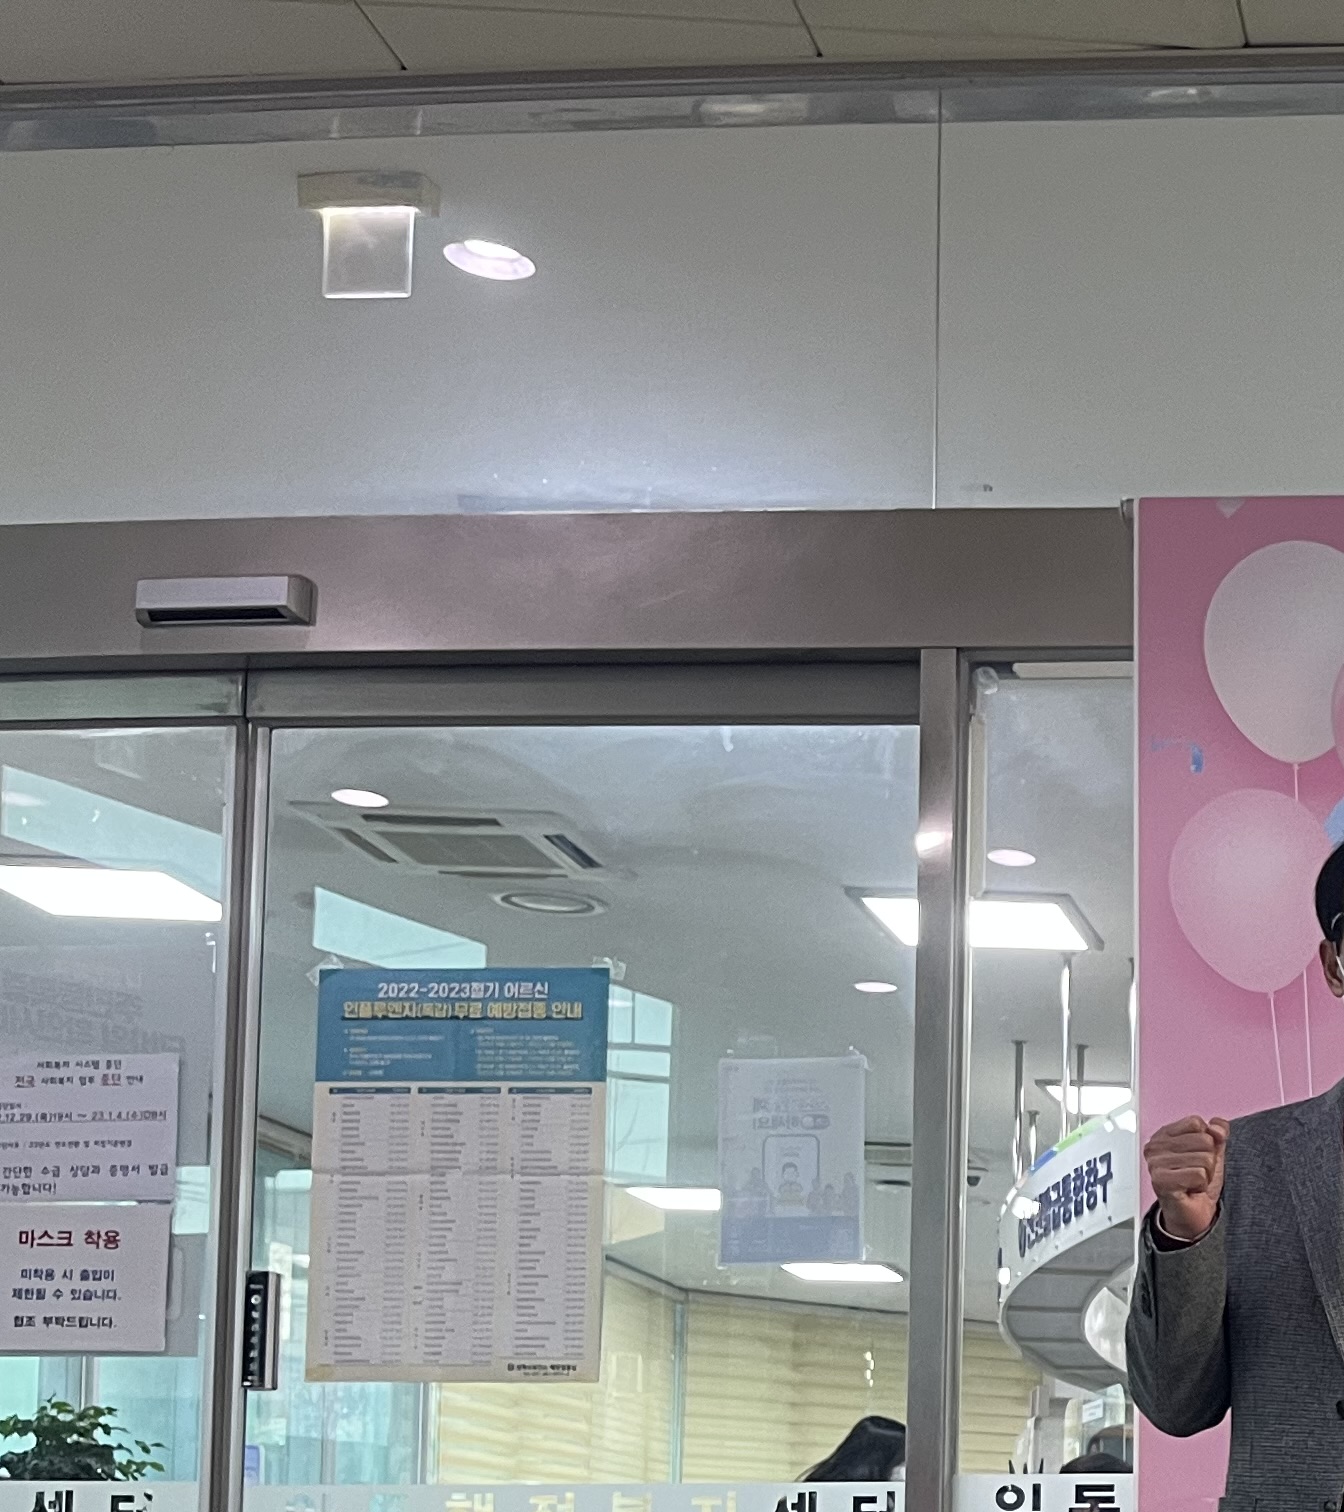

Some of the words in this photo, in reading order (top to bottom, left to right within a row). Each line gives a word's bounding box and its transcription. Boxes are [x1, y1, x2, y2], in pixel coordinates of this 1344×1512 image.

[504, 982, 549, 999] 어르신
[551, 1001, 582, 1018] 안내
[19, 1230, 74, 1247] 마스크
[84, 1229, 121, 1249] 착용
[20, 1268, 55, 1282] 미착용
[62, 1268, 73, 1281] 시
[80, 1268, 115, 1282] 출입이
[52, 1288, 64, 1300] 수
[70, 1287, 121, 1301] 있습니다.
[13, 1315, 36, 1328] 협조
[43, 1315, 117, 1329] 부탁드립니다.
